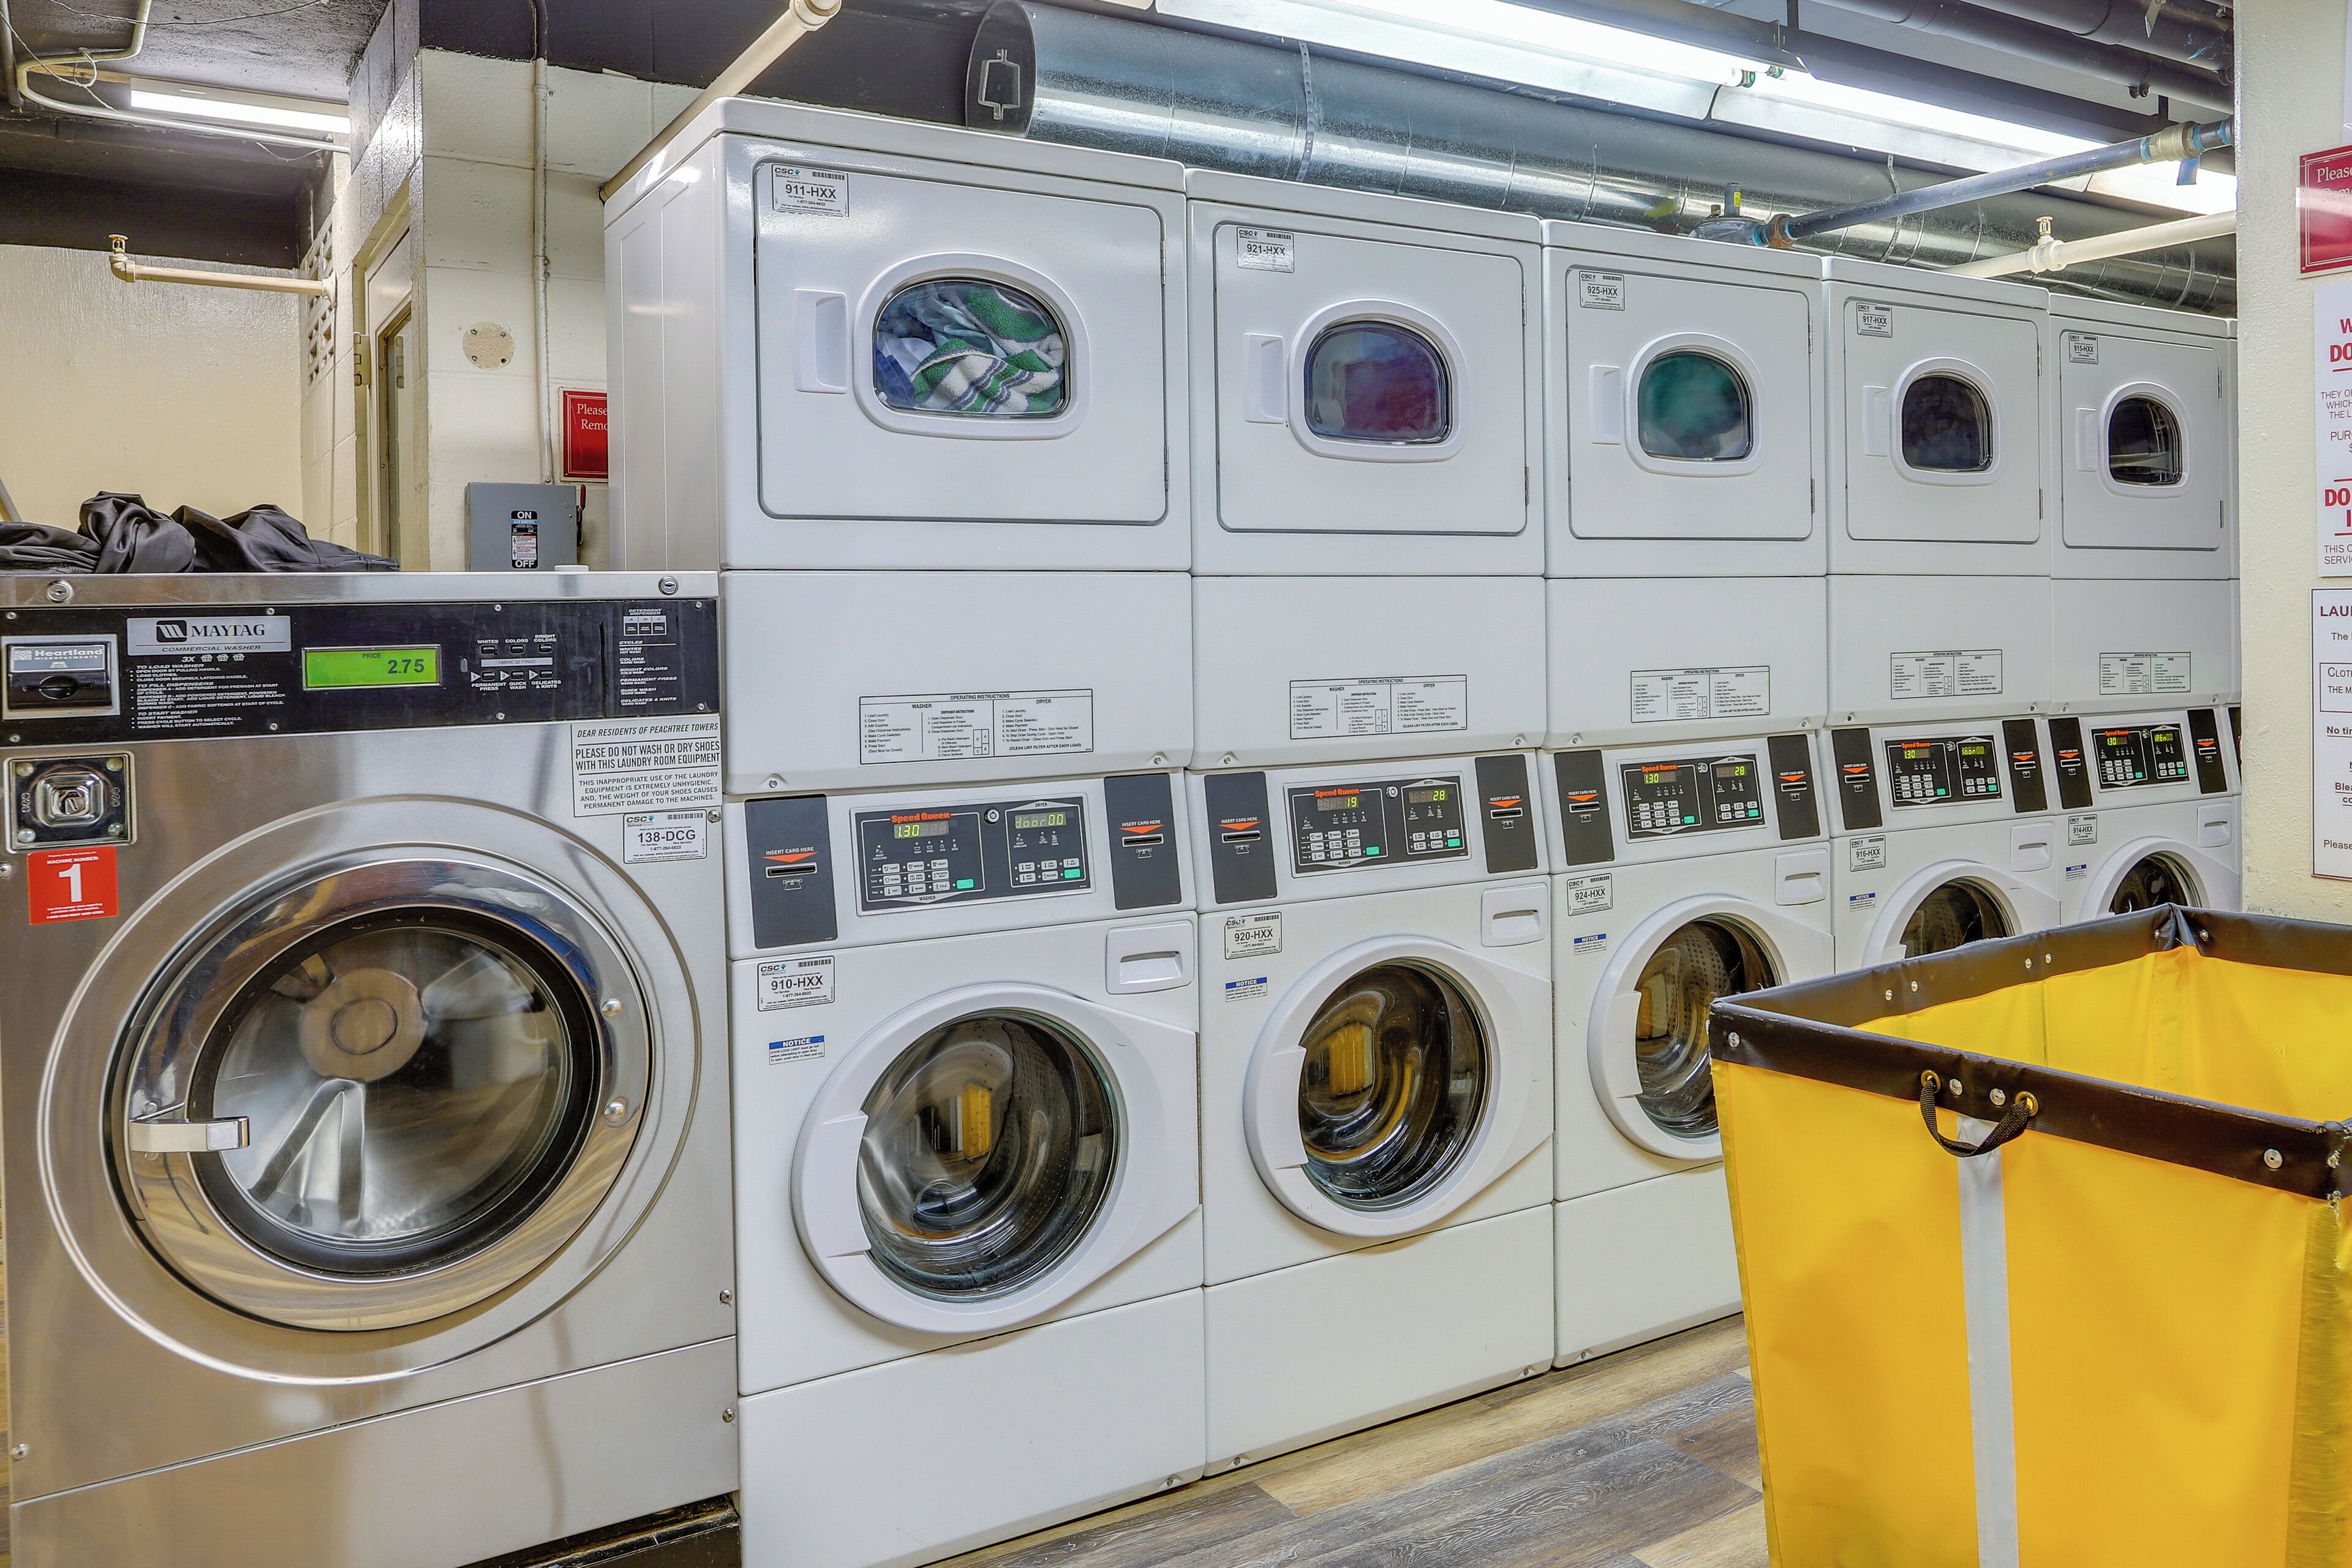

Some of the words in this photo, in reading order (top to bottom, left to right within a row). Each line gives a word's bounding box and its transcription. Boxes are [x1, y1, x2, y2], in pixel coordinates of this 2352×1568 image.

[785, 183, 837, 199] 911-HXX
[1246, 243, 1285, 255] 921-HXX
[1587, 285, 1618, 296] 925-HXX
[1862, 315, 1887, 325] 917-HXX
[2073, 344, 2094, 353] 915-HXX
[2329, 342, 2352, 363] DO
[2320, 390, 2342, 400] THEY
[2329, 410, 2345, 420] THE
[2330, 429, 2352, 442] PUR
[2324, 488, 2351, 507] DO
[516, 511, 532, 519] ON
[2323, 544, 2345, 554] THIS
[514, 559, 535, 568] OFF
[2320, 605, 2352, 617] LAU
[191, 624, 265, 637] MAYTAG
[2331, 632, 2348, 641] The
[34, 648, 103, 657] Heartland
[387, 658, 424, 674] 2.75
[2328, 685, 2343, 695] THE
[576, 729, 597, 737] DEAR
[597, 726, 637, 737] RESIDENTS
[638, 726, 649, 734] OF
[649, 724, 690, 734] PEACHTREE
[691, 723, 718, 731] TOWERS
[2326, 726, 2340, 735] No
[575, 747, 606, 759] PLEASE
[608, 746, 619, 757] DO
[622, 745, 638, 756] NOT
[639, 744, 662, 755] WASH
[664, 743, 675, 753] OR
[677, 742, 693, 753] DRY
[695, 741, 720, 752] SHOES
[575, 760, 596, 771] WITH
[597, 758, 615, 769] THIS
[617, 756, 652, 768] LAUNDRY
[654, 755, 676, 766] ROOM
[678, 752, 720, 764] EQUIPMENT
[1735, 766, 1744, 776] 28
[596, 775, 648, 785] INAPPROPRIATE
[1645, 773, 1659, 783] 1.30
[584, 785, 624, 794] EQUIPMENT
[633, 782, 671, 790] EXTREMELY
[1433, 790, 1445, 801] 28
[584, 801, 625, 809] PERMANENT
[1347, 796, 1357, 807] 19
[891, 815, 920, 824] Speed
[921, 812, 951, 821] Queen
[898, 824, 919, 837] 1.30
[2073, 826, 2093, 834] 914-HXX
[638, 829, 696, 843] 138-DCG
[2323, 839, 2352, 851] Please
[1856, 848, 1880, 859] 916-HXX
[58, 863, 82, 902] 1
[1575, 888, 1605, 900] 924-HXX
[1234, 928, 1273, 942] 920-HXX
[771, 974, 823, 990] 910-HXX
[1235, 979, 1257, 987] NOTICE
[782, 1038, 811, 1048] NOTICE
